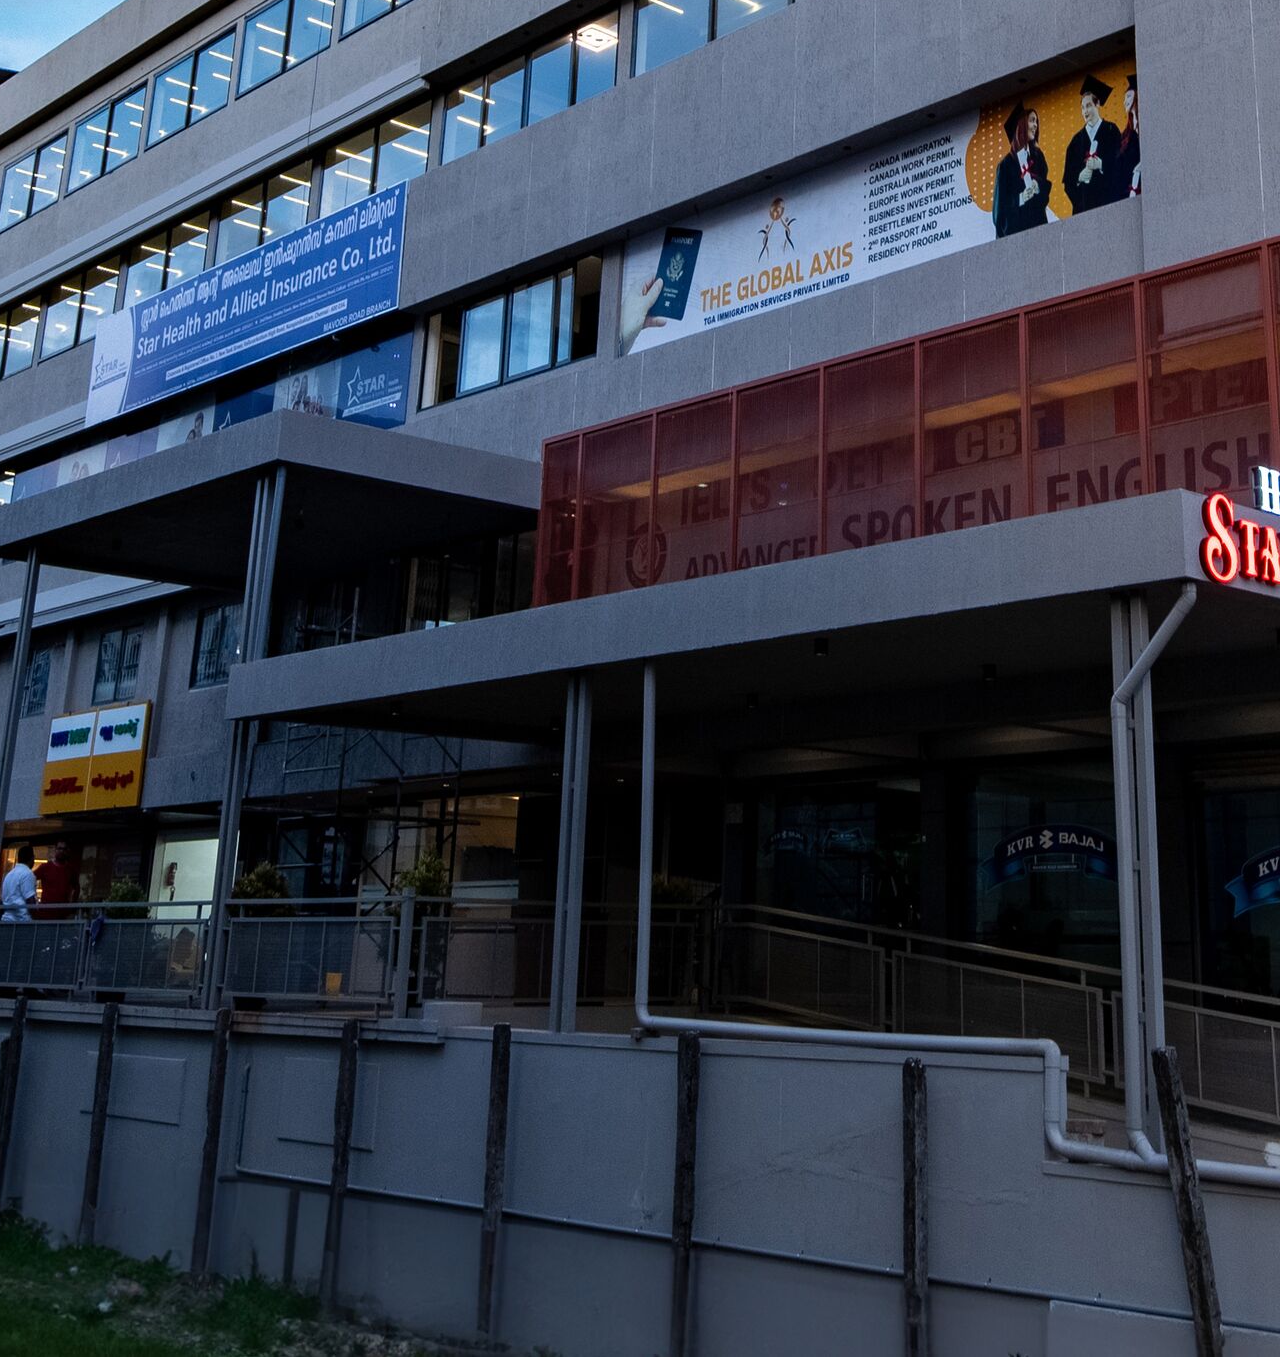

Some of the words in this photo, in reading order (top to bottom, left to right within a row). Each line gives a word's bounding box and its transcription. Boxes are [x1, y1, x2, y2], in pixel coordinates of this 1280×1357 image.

[869, 154, 900, 172] CANADA
[901, 135, 952, 159] IMMIGRATION.
[869, 168, 900, 185] CANADA
[901, 158, 924, 173] WORK
[926, 147, 955, 163] PERMIT.
[869, 178, 910, 198] AUSTRALIA
[912, 158, 963, 181] IMMIGRATION.
[869, 193, 898, 211] EUROPE
[900, 185, 924, 199] WORK
[926, 174, 955, 191] PERMIT.
[869, 205, 905, 224] BUSINESS
[907, 187, 956, 211] INVESTMENT.
[869, 210, 926, 237] RESETTLEMENT
[868, 244, 909, 263] RESIDENCY
[911, 229, 952, 249] PROGRAM.
[880, 226, 919, 246] PASSPORT
[921, 220, 937, 233] AND
[136, 335, 159, 359] Star
[162, 313, 200, 348] Health
[204, 301, 227, 329] and
[230, 279, 268, 318] Allied
[271, 259, 337, 302] Insurance
[341, 247, 364, 271] Co.
[369, 228, 396, 260] Ltd.
[700, 281, 731, 312] THE
[737, 259, 804, 302] GLOBAL
[809, 241, 853, 278] AXIS
[323, 317, 348, 332] MAVOOR
[349, 310, 365, 324] ROAD
[366, 299, 391, 316] BRANCH
[704, 315, 716, 326] TGA
[717, 303, 759, 322] IMMIGRATION
[760, 291, 792, 308] SERVICES
[793, 282, 820, 297] PRIVATE
[822, 273, 850, 288] LIMITED
[356, 373, 386, 396] STAR
[841, 485, 1011, 548] SPOKEN
[1047, 433, 1270, 512] ENGLISH
[1006, 836, 1034, 857] KVR
[1059, 832, 1105, 852] BAJAJ
